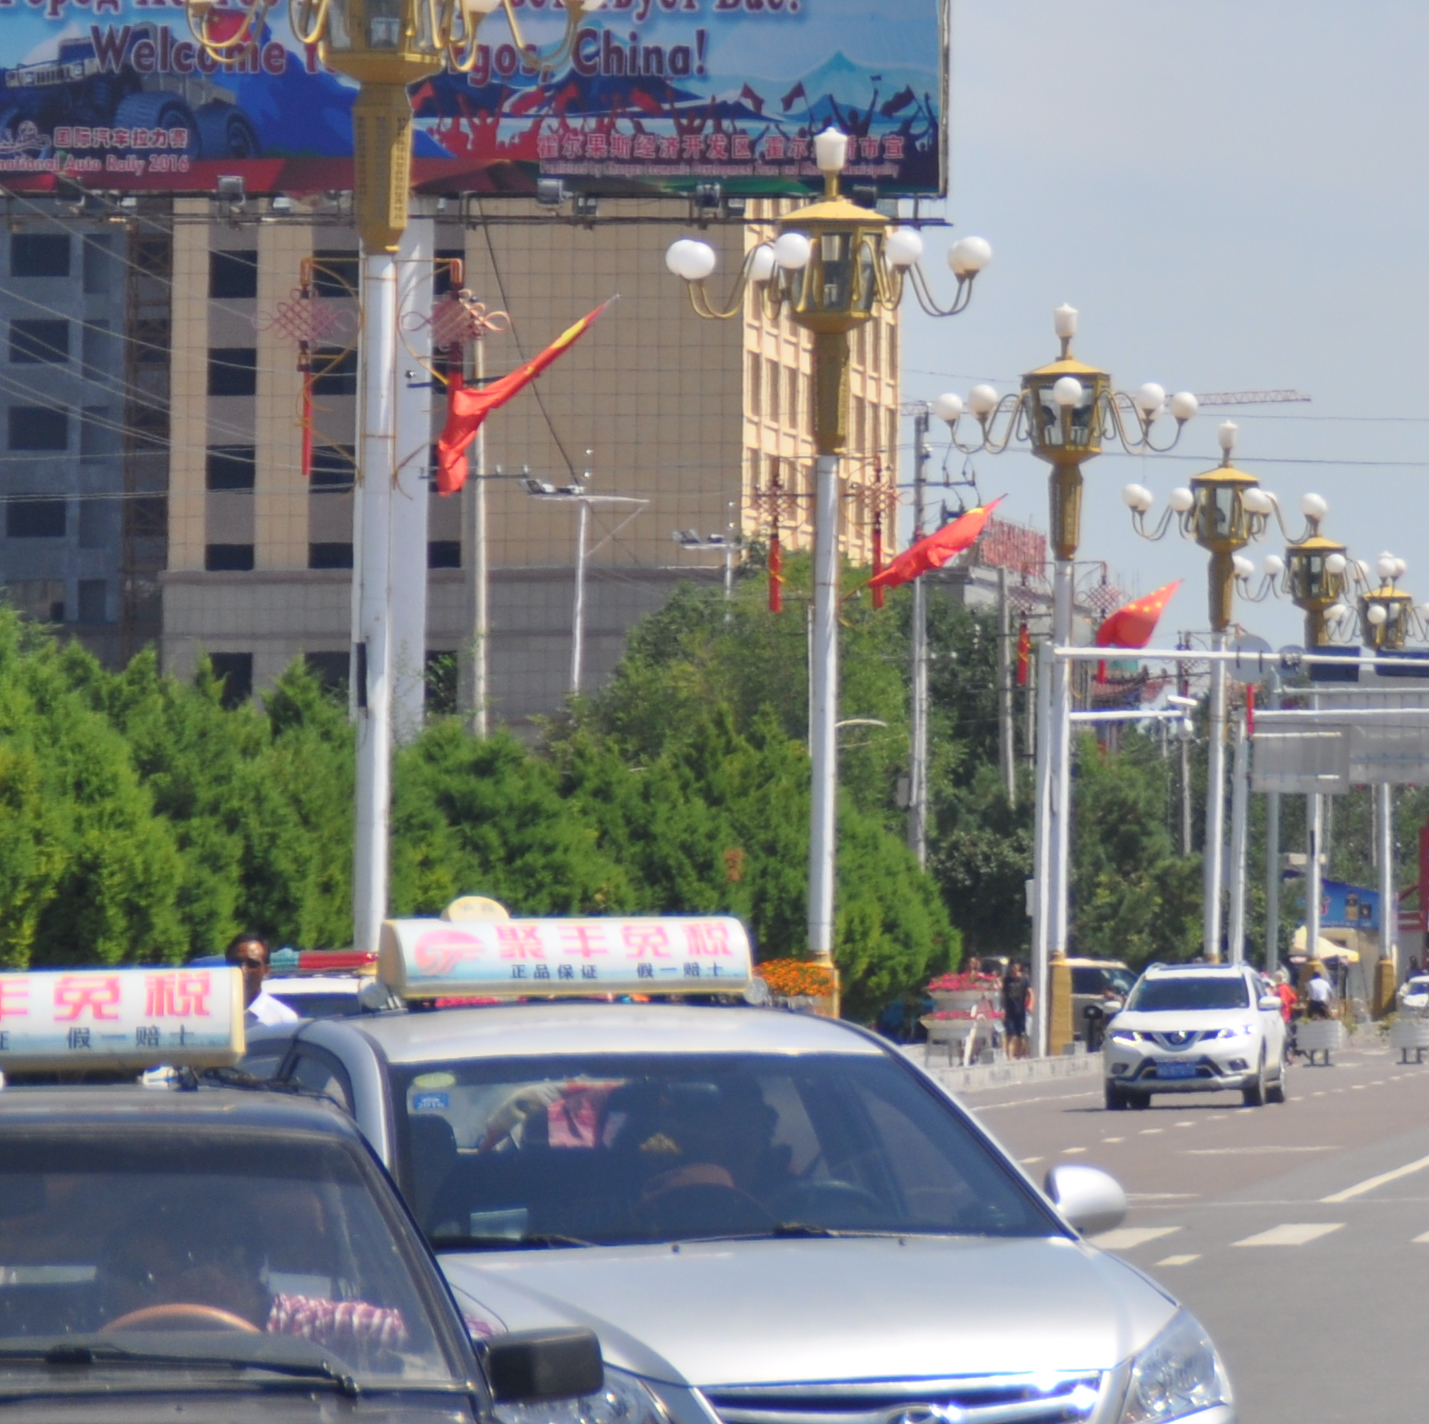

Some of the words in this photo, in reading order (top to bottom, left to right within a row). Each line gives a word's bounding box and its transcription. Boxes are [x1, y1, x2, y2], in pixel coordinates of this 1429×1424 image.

[90, 23, 287, 75] Welcome
[572, 26, 709, 77] China!
[536, 132, 752, 160] 霍尔果斯经济开发区
[764, 133, 905, 160] 霍尔市宣
[148, 154, 190, 173] 2016
[510, 963, 599, 980] 正品保证
